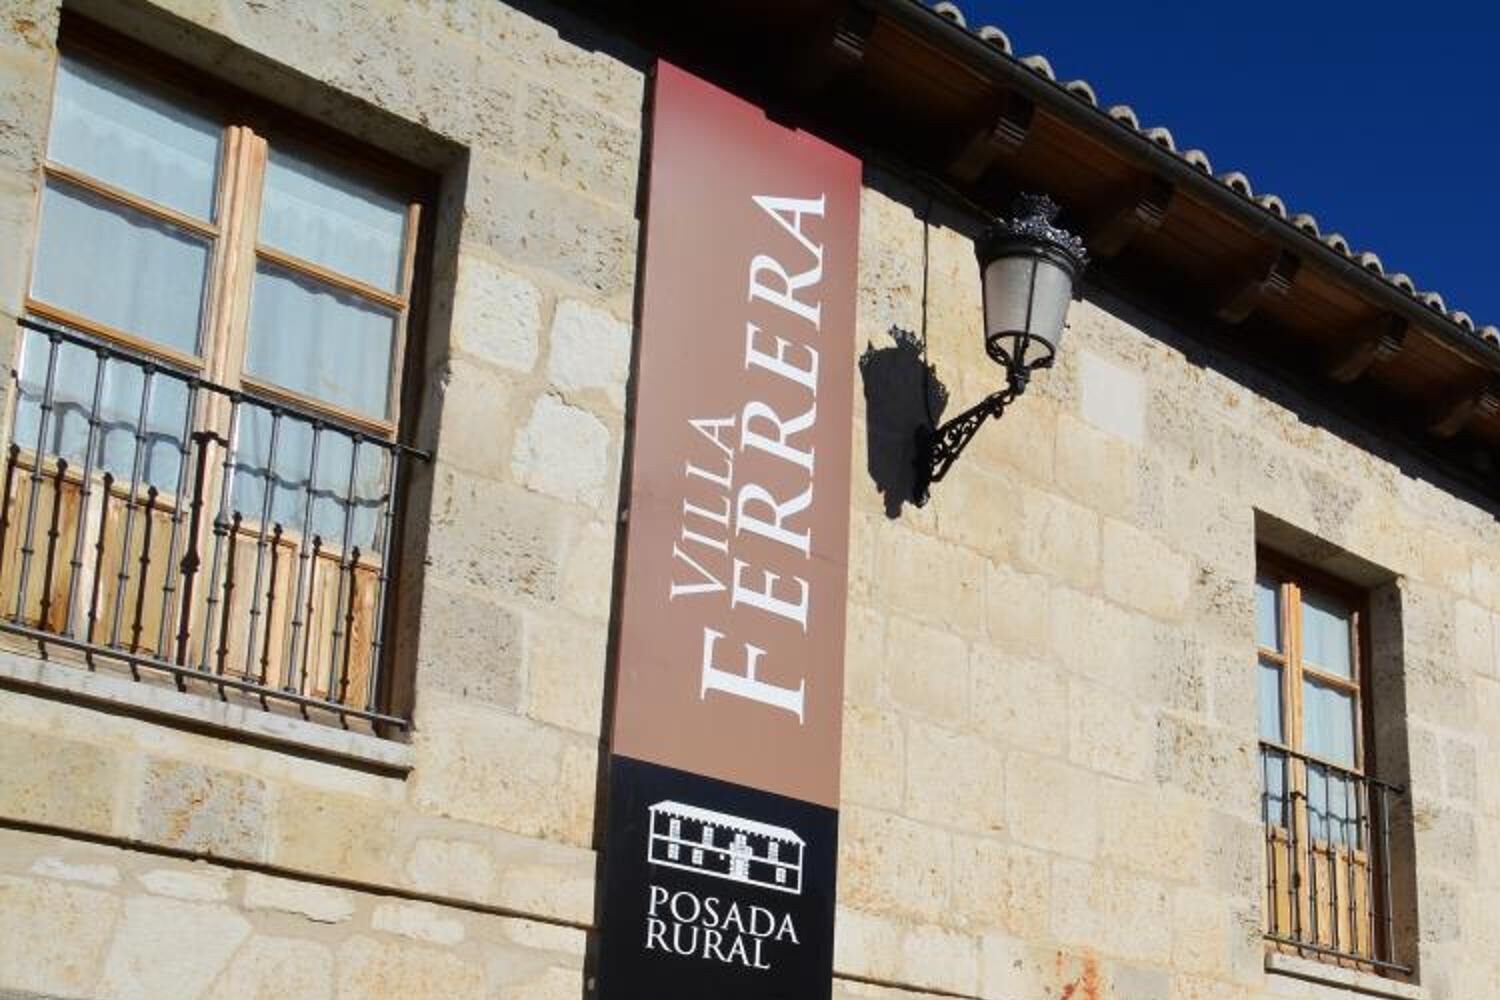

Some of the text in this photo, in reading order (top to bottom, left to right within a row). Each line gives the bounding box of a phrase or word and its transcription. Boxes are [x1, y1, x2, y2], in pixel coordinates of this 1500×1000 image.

[669, 412, 737, 601] VILLA
[700, 192, 826, 725] FERRERA
[645, 917, 771, 970] RURAL
[648, 885, 800, 945] POSADA
